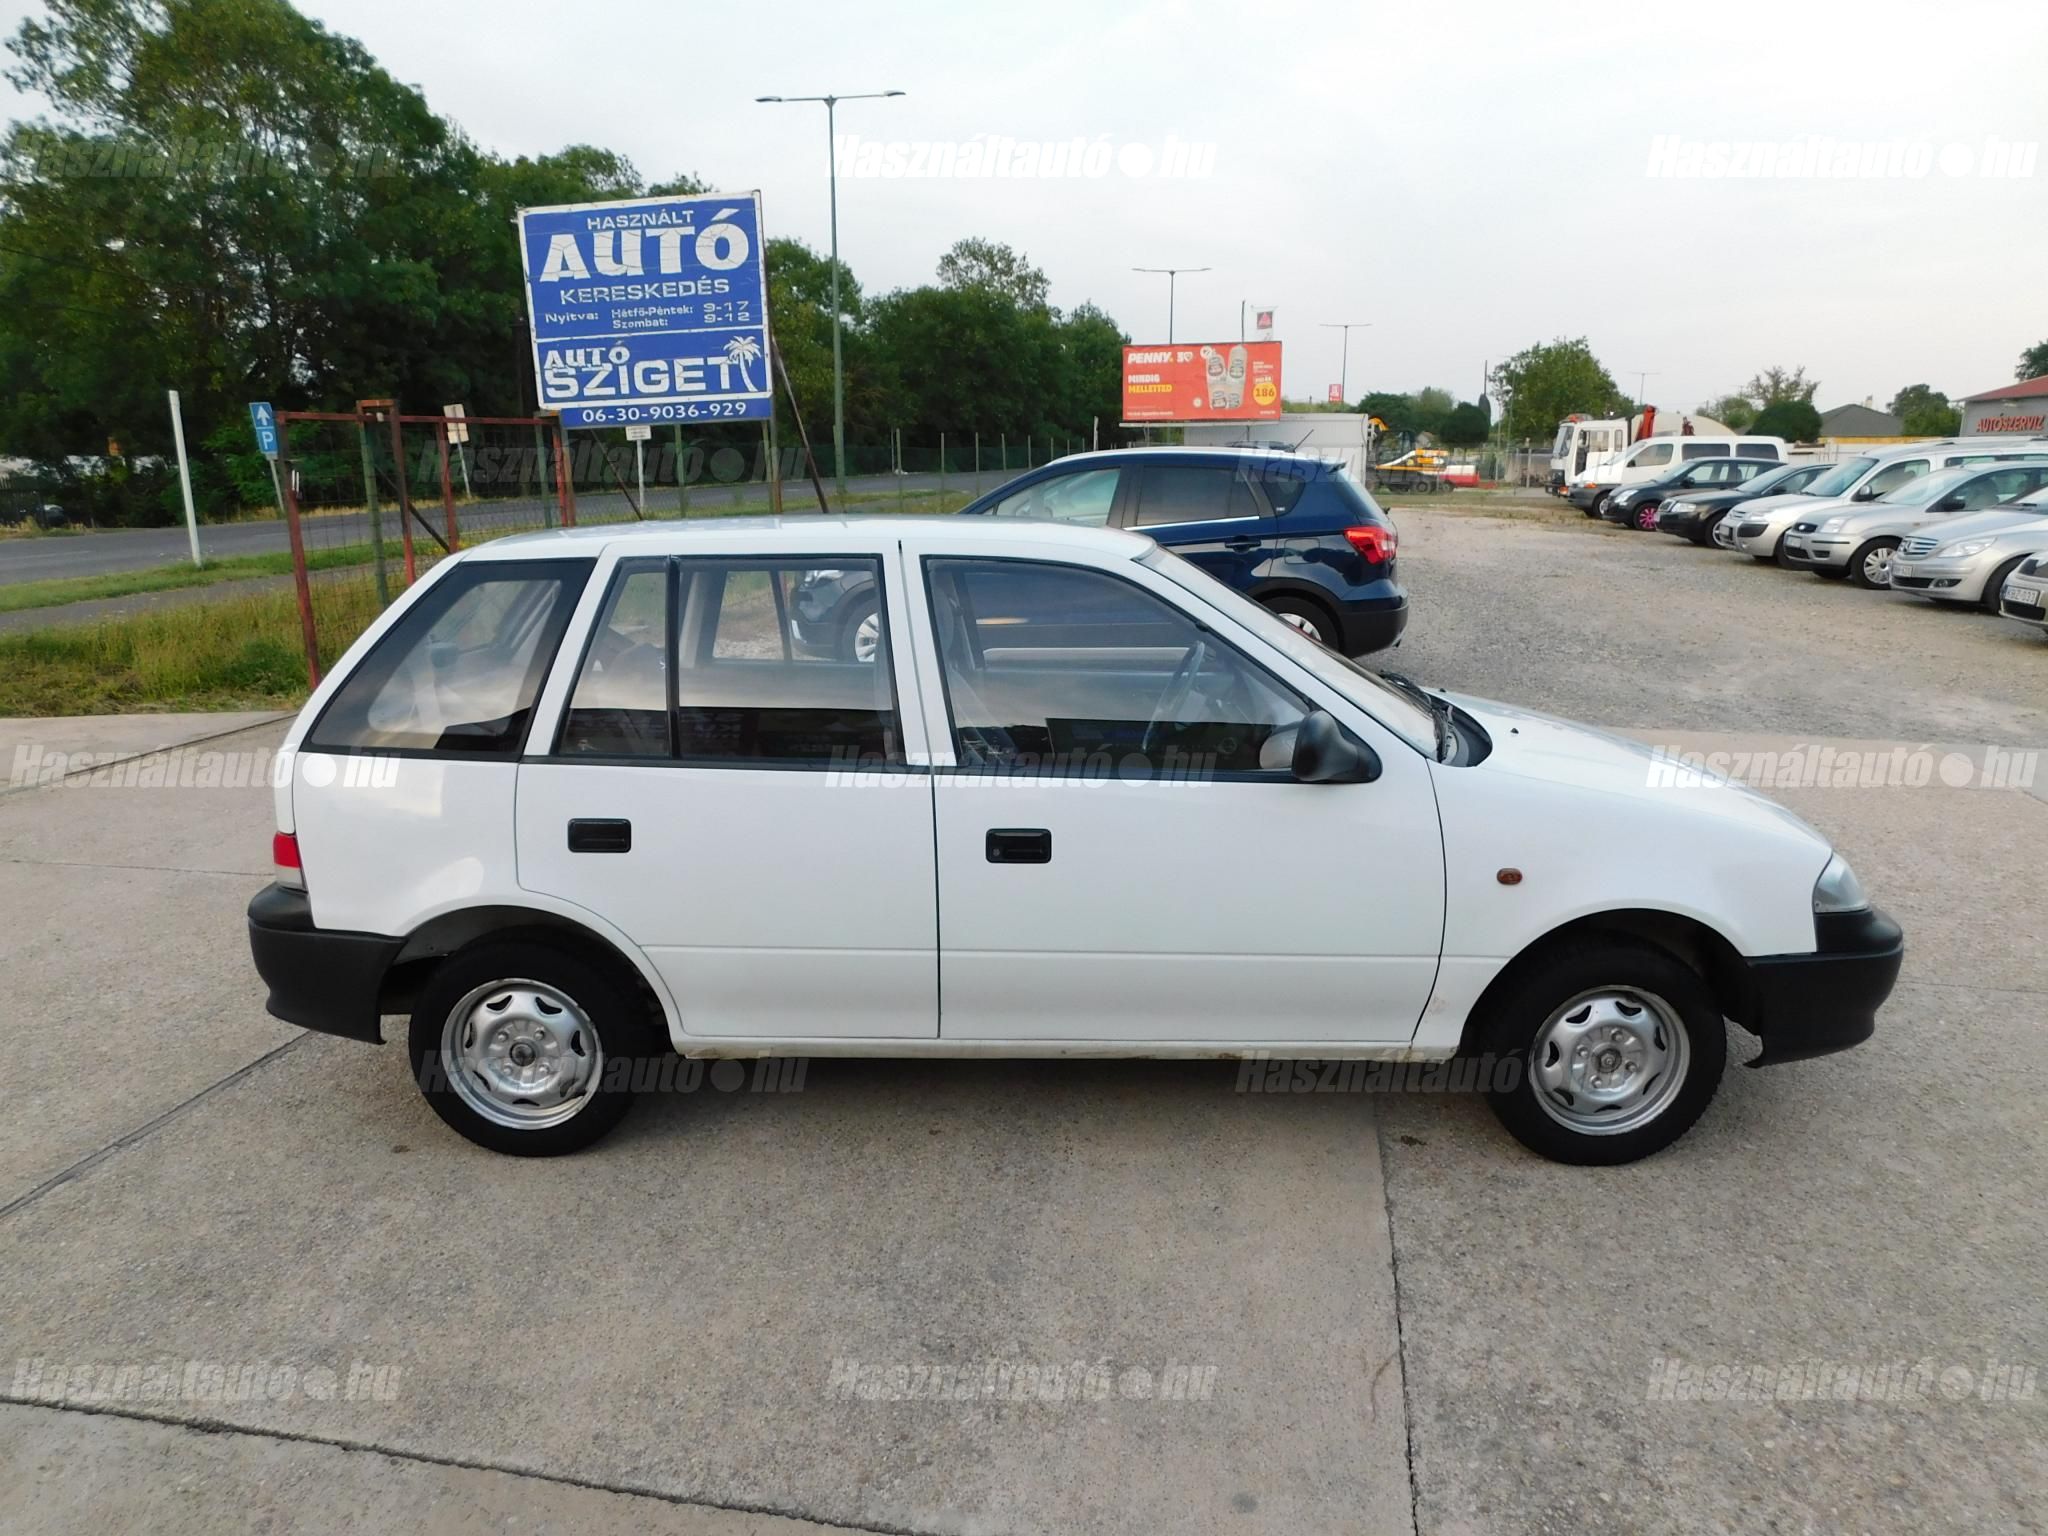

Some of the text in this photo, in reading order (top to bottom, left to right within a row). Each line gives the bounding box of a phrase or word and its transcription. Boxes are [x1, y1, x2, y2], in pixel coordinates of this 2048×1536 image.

[587, 208, 694, 230] HASZNÁLT
[539, 208, 749, 282] AUTÓ
[560, 275, 730, 305] KERESKEDÉS
[545, 313, 599, 325] Nyitva:
[613, 318, 668, 329] Szombat:
[544, 340, 630, 370] AUTÓ
[545, 357, 738, 398] SZIGET
[1255, 388, 1275, 397] 186
[582, 402, 747, 422] 06-30-9036-929
[262, 431, 273, 450] P
